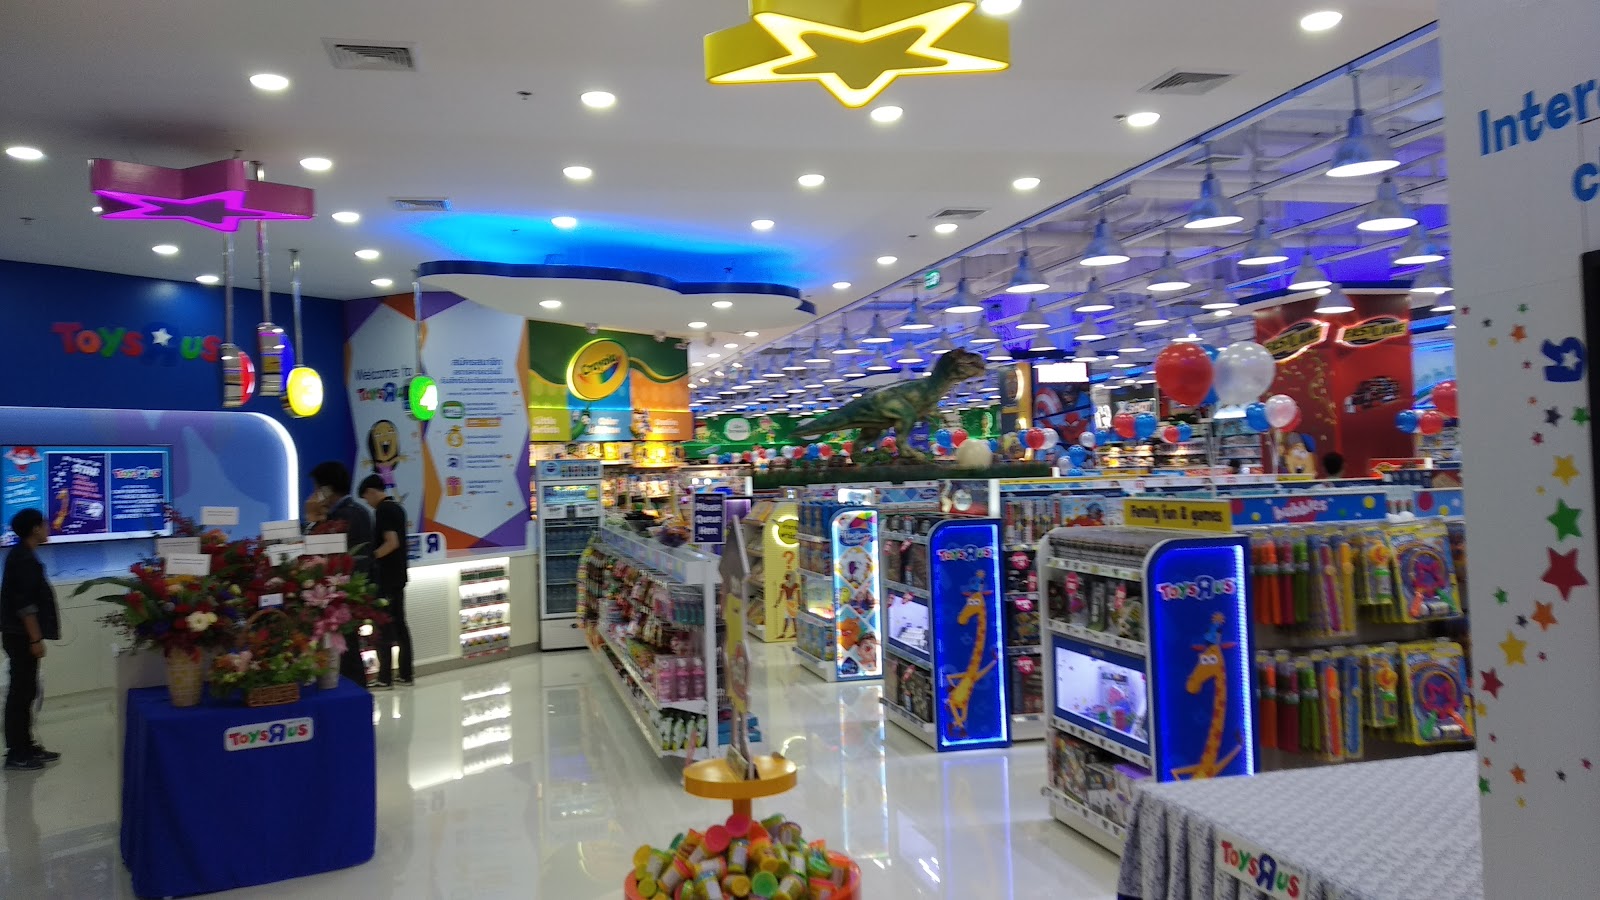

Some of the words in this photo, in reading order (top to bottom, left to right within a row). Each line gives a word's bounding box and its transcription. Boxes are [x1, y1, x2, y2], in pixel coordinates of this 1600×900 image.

[1477, 78, 1600, 157] Inter
[353, 367, 399, 380] Welcome
[696, 502, 722, 512] Please
[1130, 504, 1159, 524] Family
[1162, 503, 1178, 520] fun
[1191, 510, 1223, 527] games
[1272, 499, 1328, 521] bubbles
[697, 526, 719, 535] Here
